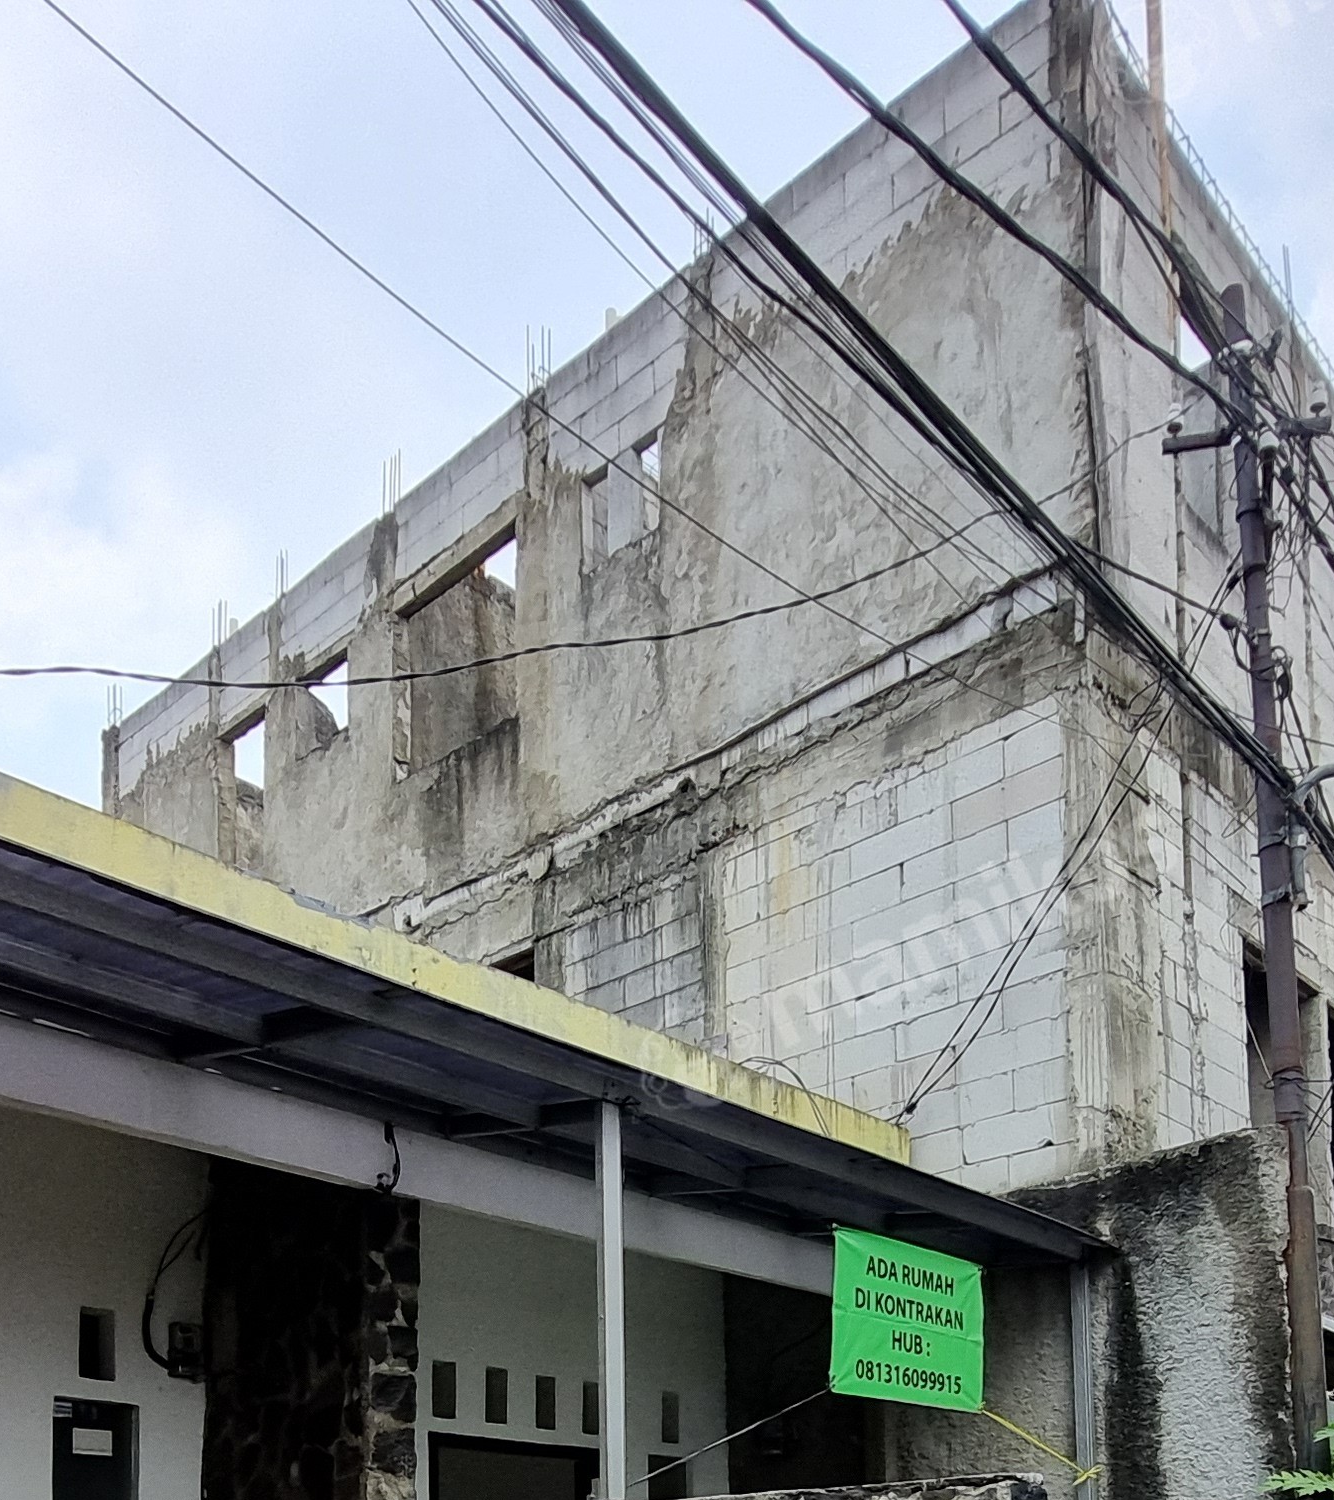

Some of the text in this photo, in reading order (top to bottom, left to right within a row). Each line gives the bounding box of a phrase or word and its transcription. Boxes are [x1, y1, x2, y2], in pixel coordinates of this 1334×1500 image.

[865, 1255, 955, 1297] ADA RUMAH
[854, 1287, 964, 1331] DI KONTRAKAN
[855, 1358, 962, 1395] 081316099915
